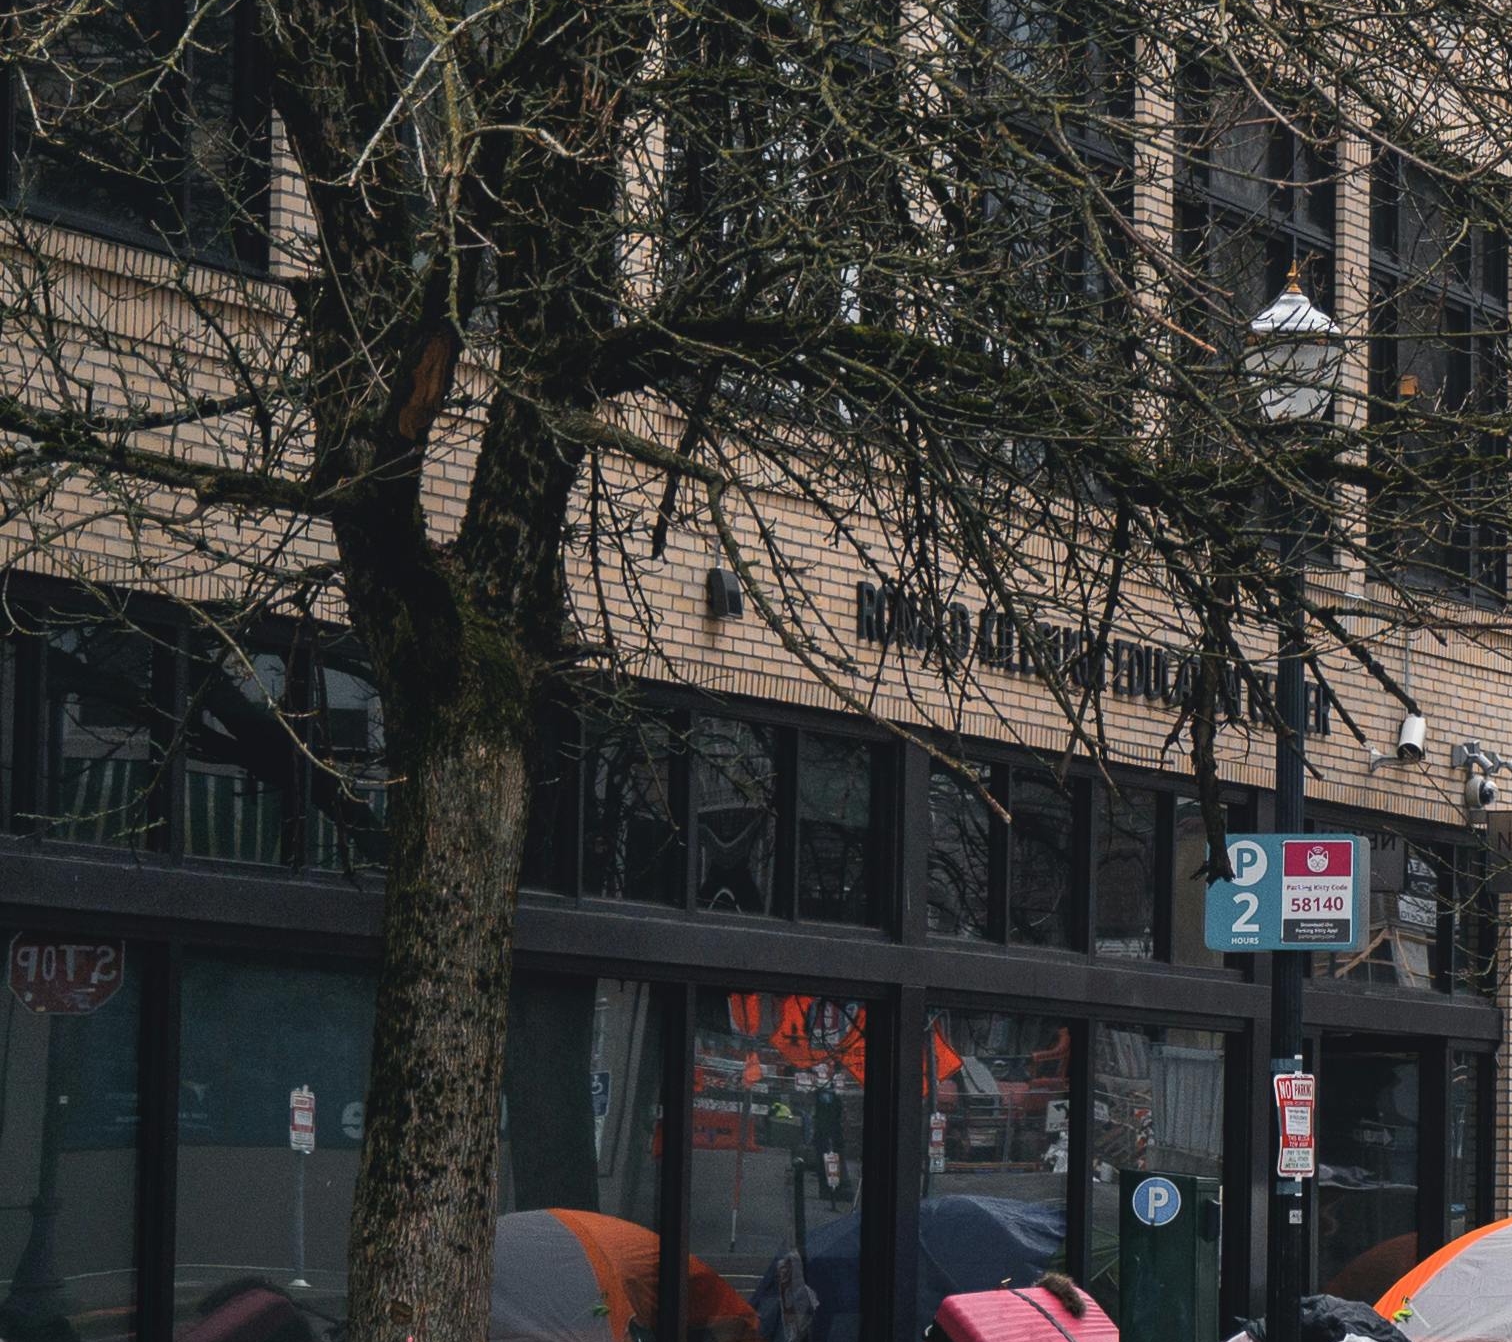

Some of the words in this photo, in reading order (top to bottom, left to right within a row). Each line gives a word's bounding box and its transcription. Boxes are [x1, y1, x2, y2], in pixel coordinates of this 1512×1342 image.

[1236, 847, 1258, 879] P
[1232, 892, 1259, 932] 2
[1291, 897, 1344, 912] 58140
[1231, 937, 1259, 945] HOURS
[1279, 1080, 1291, 1099] NO
[1148, 1187, 1169, 1218] P
